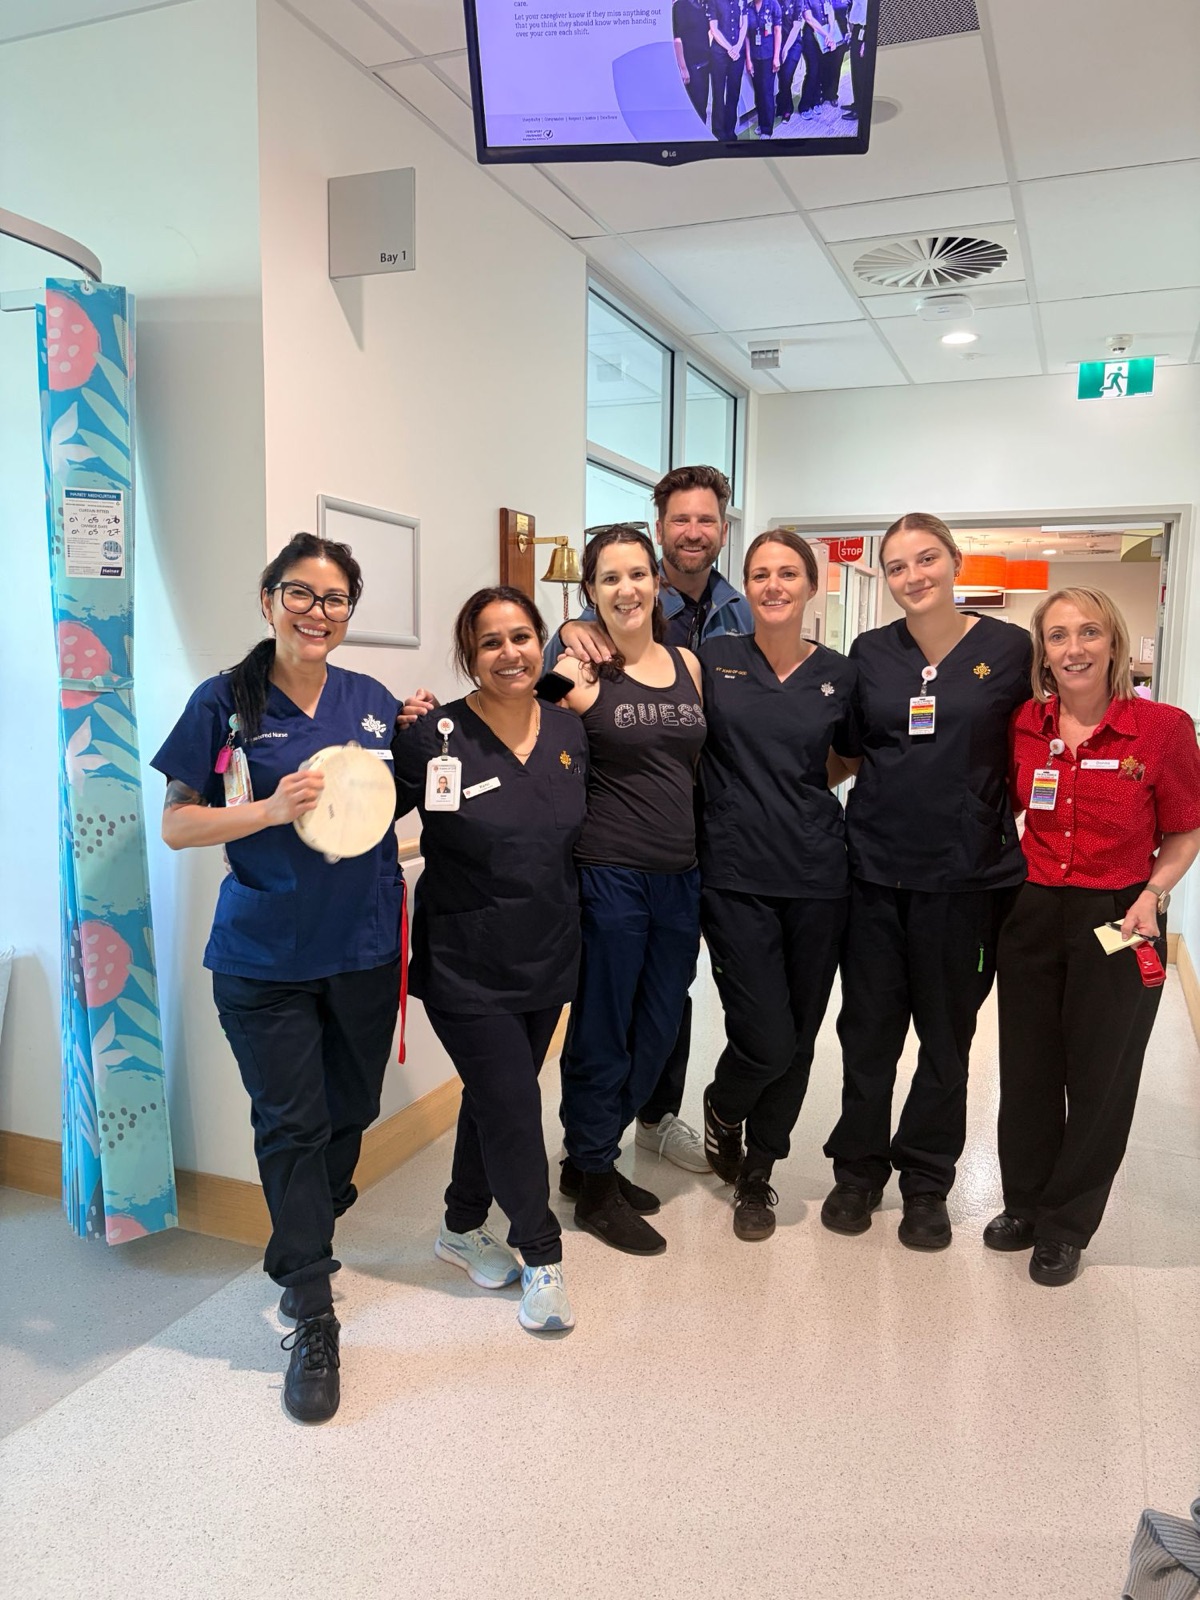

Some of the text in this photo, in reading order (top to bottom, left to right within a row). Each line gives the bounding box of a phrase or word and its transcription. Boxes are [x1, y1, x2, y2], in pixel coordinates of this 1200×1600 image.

[540, 12, 567, 20] caregiver
[592, 10, 606, 18] they
[623, 9, 650, 17] anything
[558, 20, 572, 28] they
[573, 19, 594, 27] should
[631, 17, 657, 26] handing
[558, 28, 573, 36] each
[380, 250, 406, 265] Bay 1
[106, 529, 121, 537] 27
[841, 547, 863, 556] STOP
[614, 703, 707, 729] GUESS
